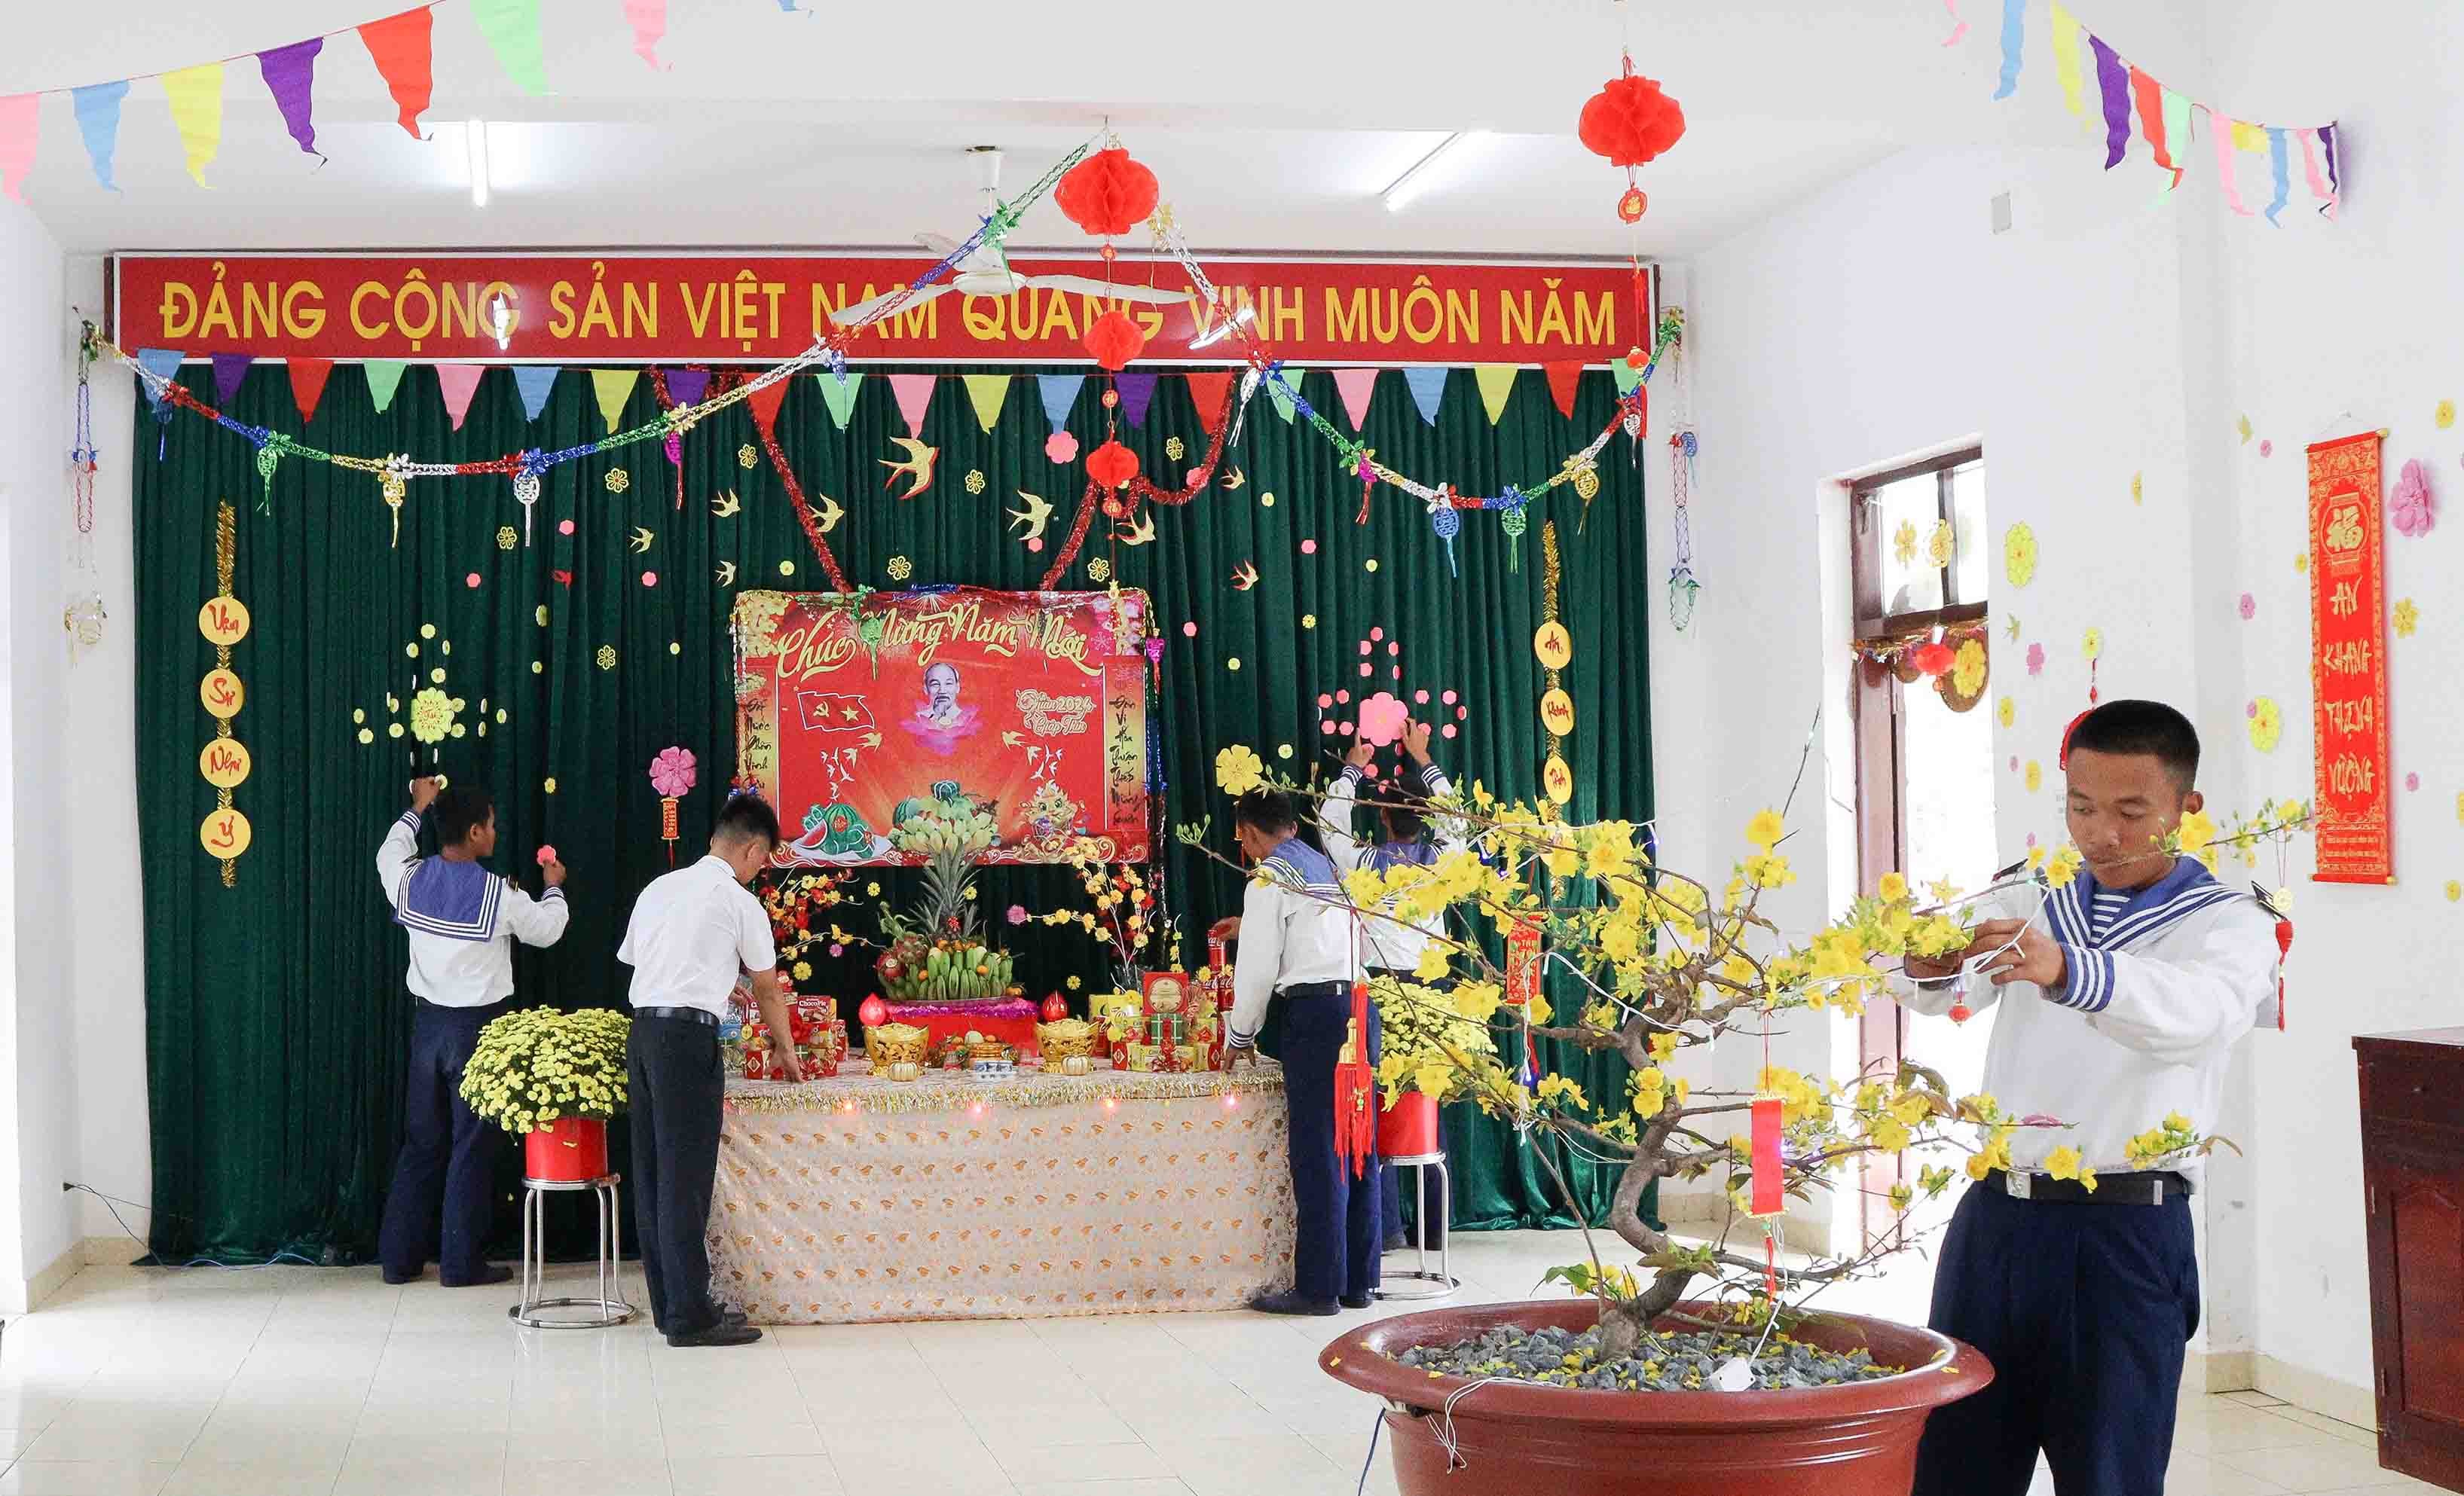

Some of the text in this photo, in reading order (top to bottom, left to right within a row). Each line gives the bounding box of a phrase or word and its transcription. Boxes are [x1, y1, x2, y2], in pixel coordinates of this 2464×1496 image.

[159, 261, 326, 339] ĐẢNG
[350, 268, 518, 352] CỘNG
[549, 261, 658, 339] SẢN
[680, 270, 787, 353] VIỆT
[1183, 285, 1306, 342] VINH
[1325, 276, 1480, 344] MUÔN
[1500, 279, 1616, 345] NĂM
[777, 607, 857, 682] Chúc
[917, 603, 1018, 657] Năm
[1057, 696, 1096, 711] 2024
